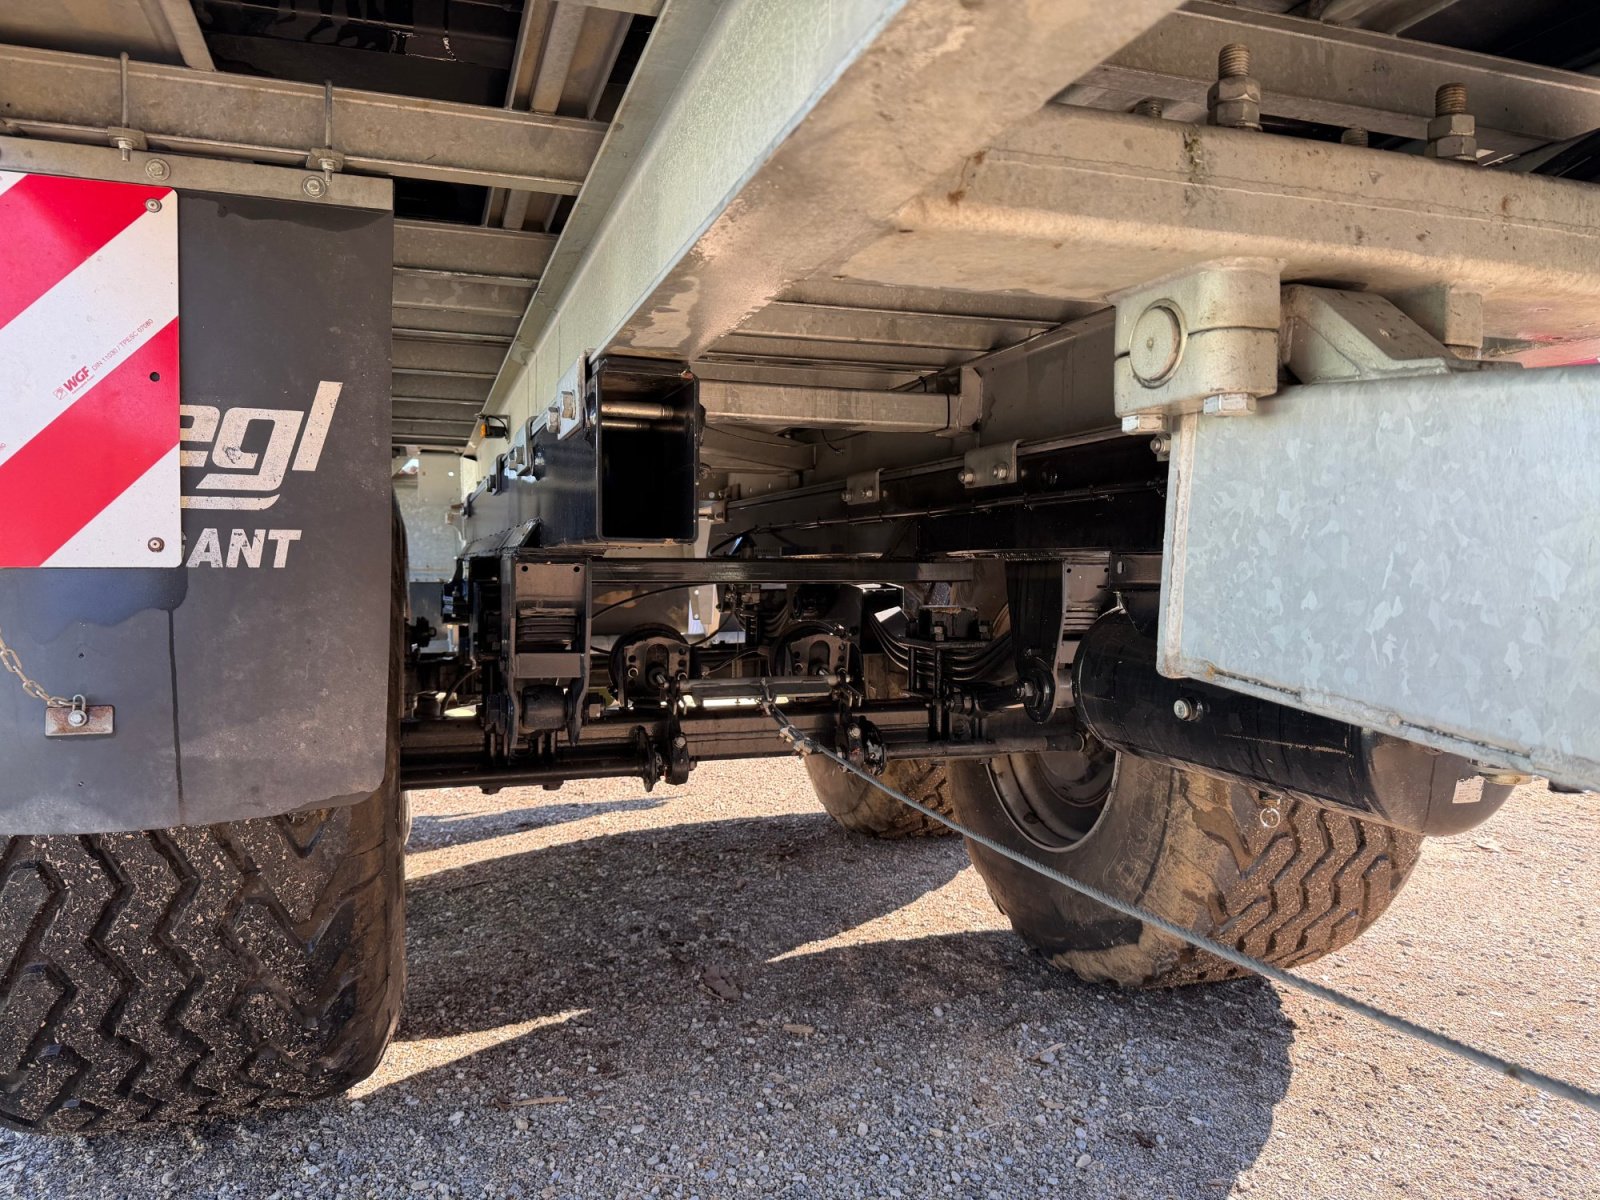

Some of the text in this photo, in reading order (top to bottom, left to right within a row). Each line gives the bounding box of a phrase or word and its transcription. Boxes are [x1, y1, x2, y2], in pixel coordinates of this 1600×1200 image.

[63, 366, 89, 391] WGF
[91, 361, 103, 371] DIN
[180, 528, 302, 568] ANT
